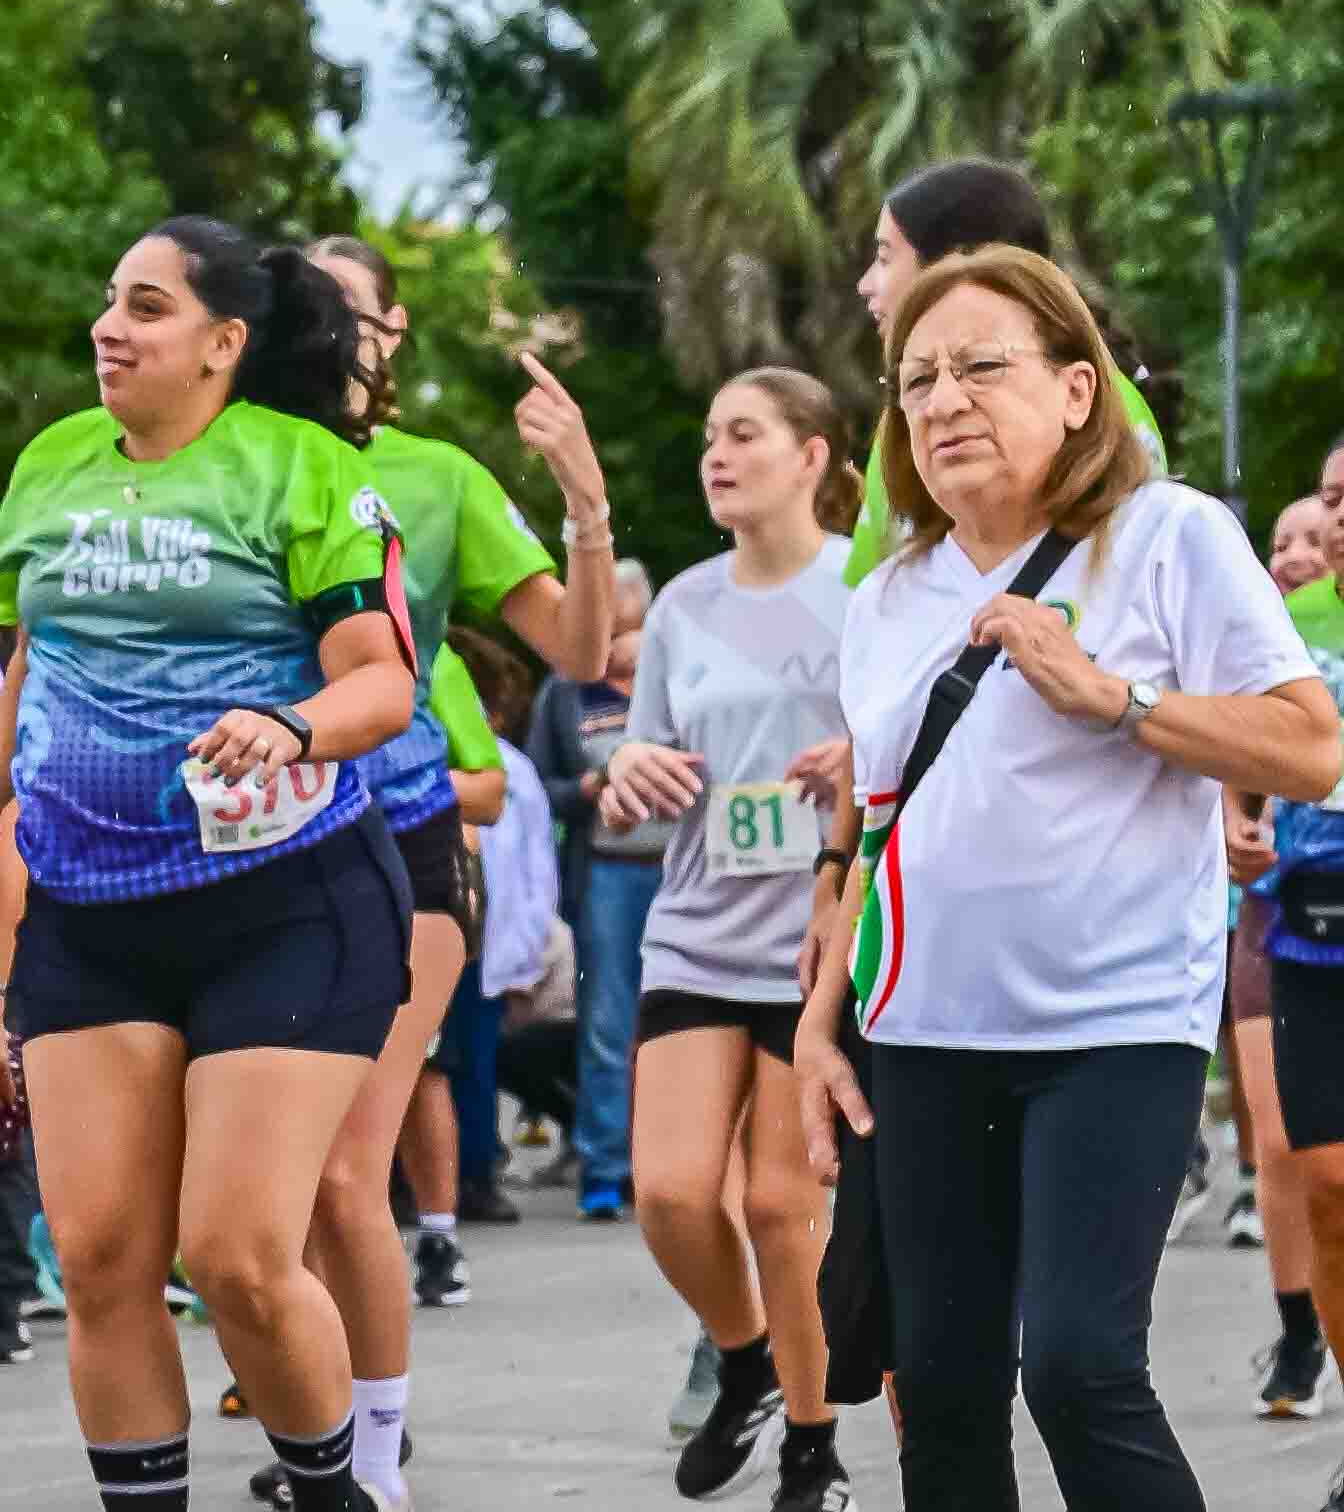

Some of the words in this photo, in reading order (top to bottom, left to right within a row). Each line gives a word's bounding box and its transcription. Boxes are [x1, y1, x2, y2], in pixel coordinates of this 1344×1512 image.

[143, 518, 211, 561] Ville
[63, 560, 211, 598] corre
[729, 792, 785, 849] 81
